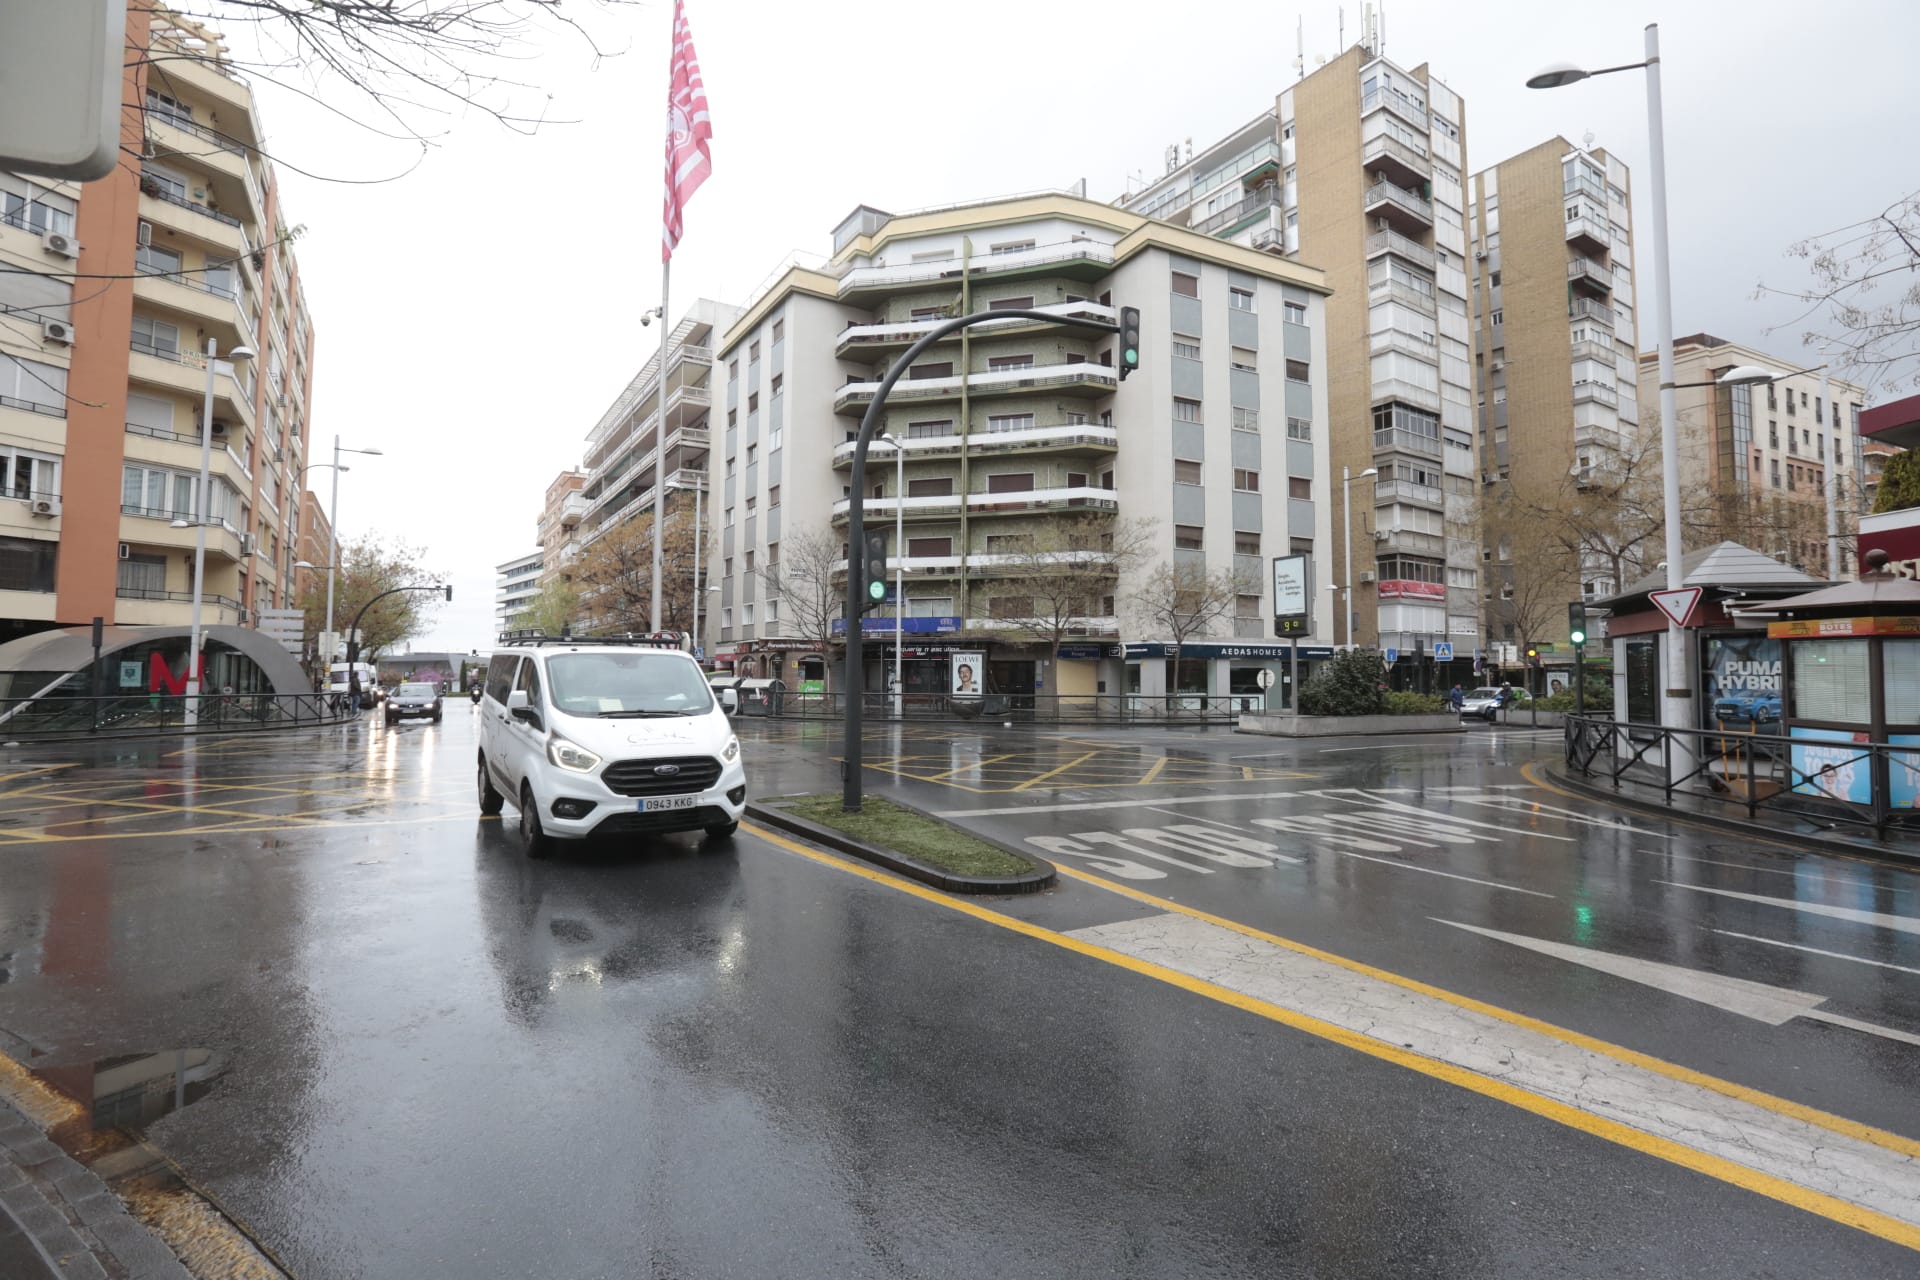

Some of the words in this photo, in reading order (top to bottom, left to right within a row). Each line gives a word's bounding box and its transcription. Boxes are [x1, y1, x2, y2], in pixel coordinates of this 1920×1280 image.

[1820, 623, 1853, 632] BOTES
[955, 655, 979, 664] LOEWE
[1725, 661, 1782, 676] PUMA
[1718, 675, 1782, 690] HYBRI
[646, 799, 672, 810] 0943
[674, 798, 693, 807] KKG
